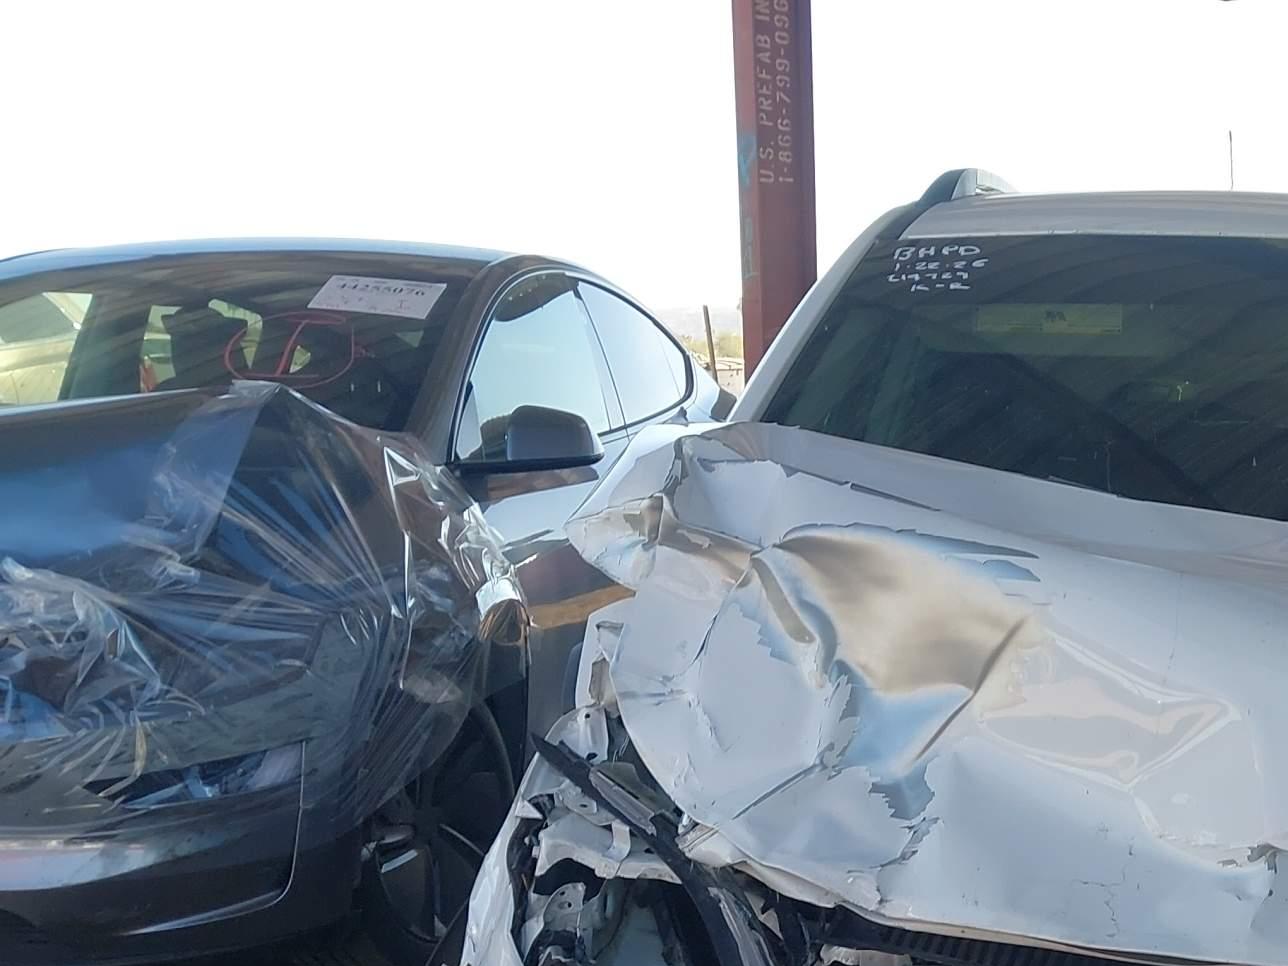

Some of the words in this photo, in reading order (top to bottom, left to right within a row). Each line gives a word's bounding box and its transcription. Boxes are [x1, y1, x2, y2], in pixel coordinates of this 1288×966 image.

[756, 34, 774, 127] PREFAB
[759, 140, 776, 184] U.S.
[893, 244, 981, 261] BHPD
